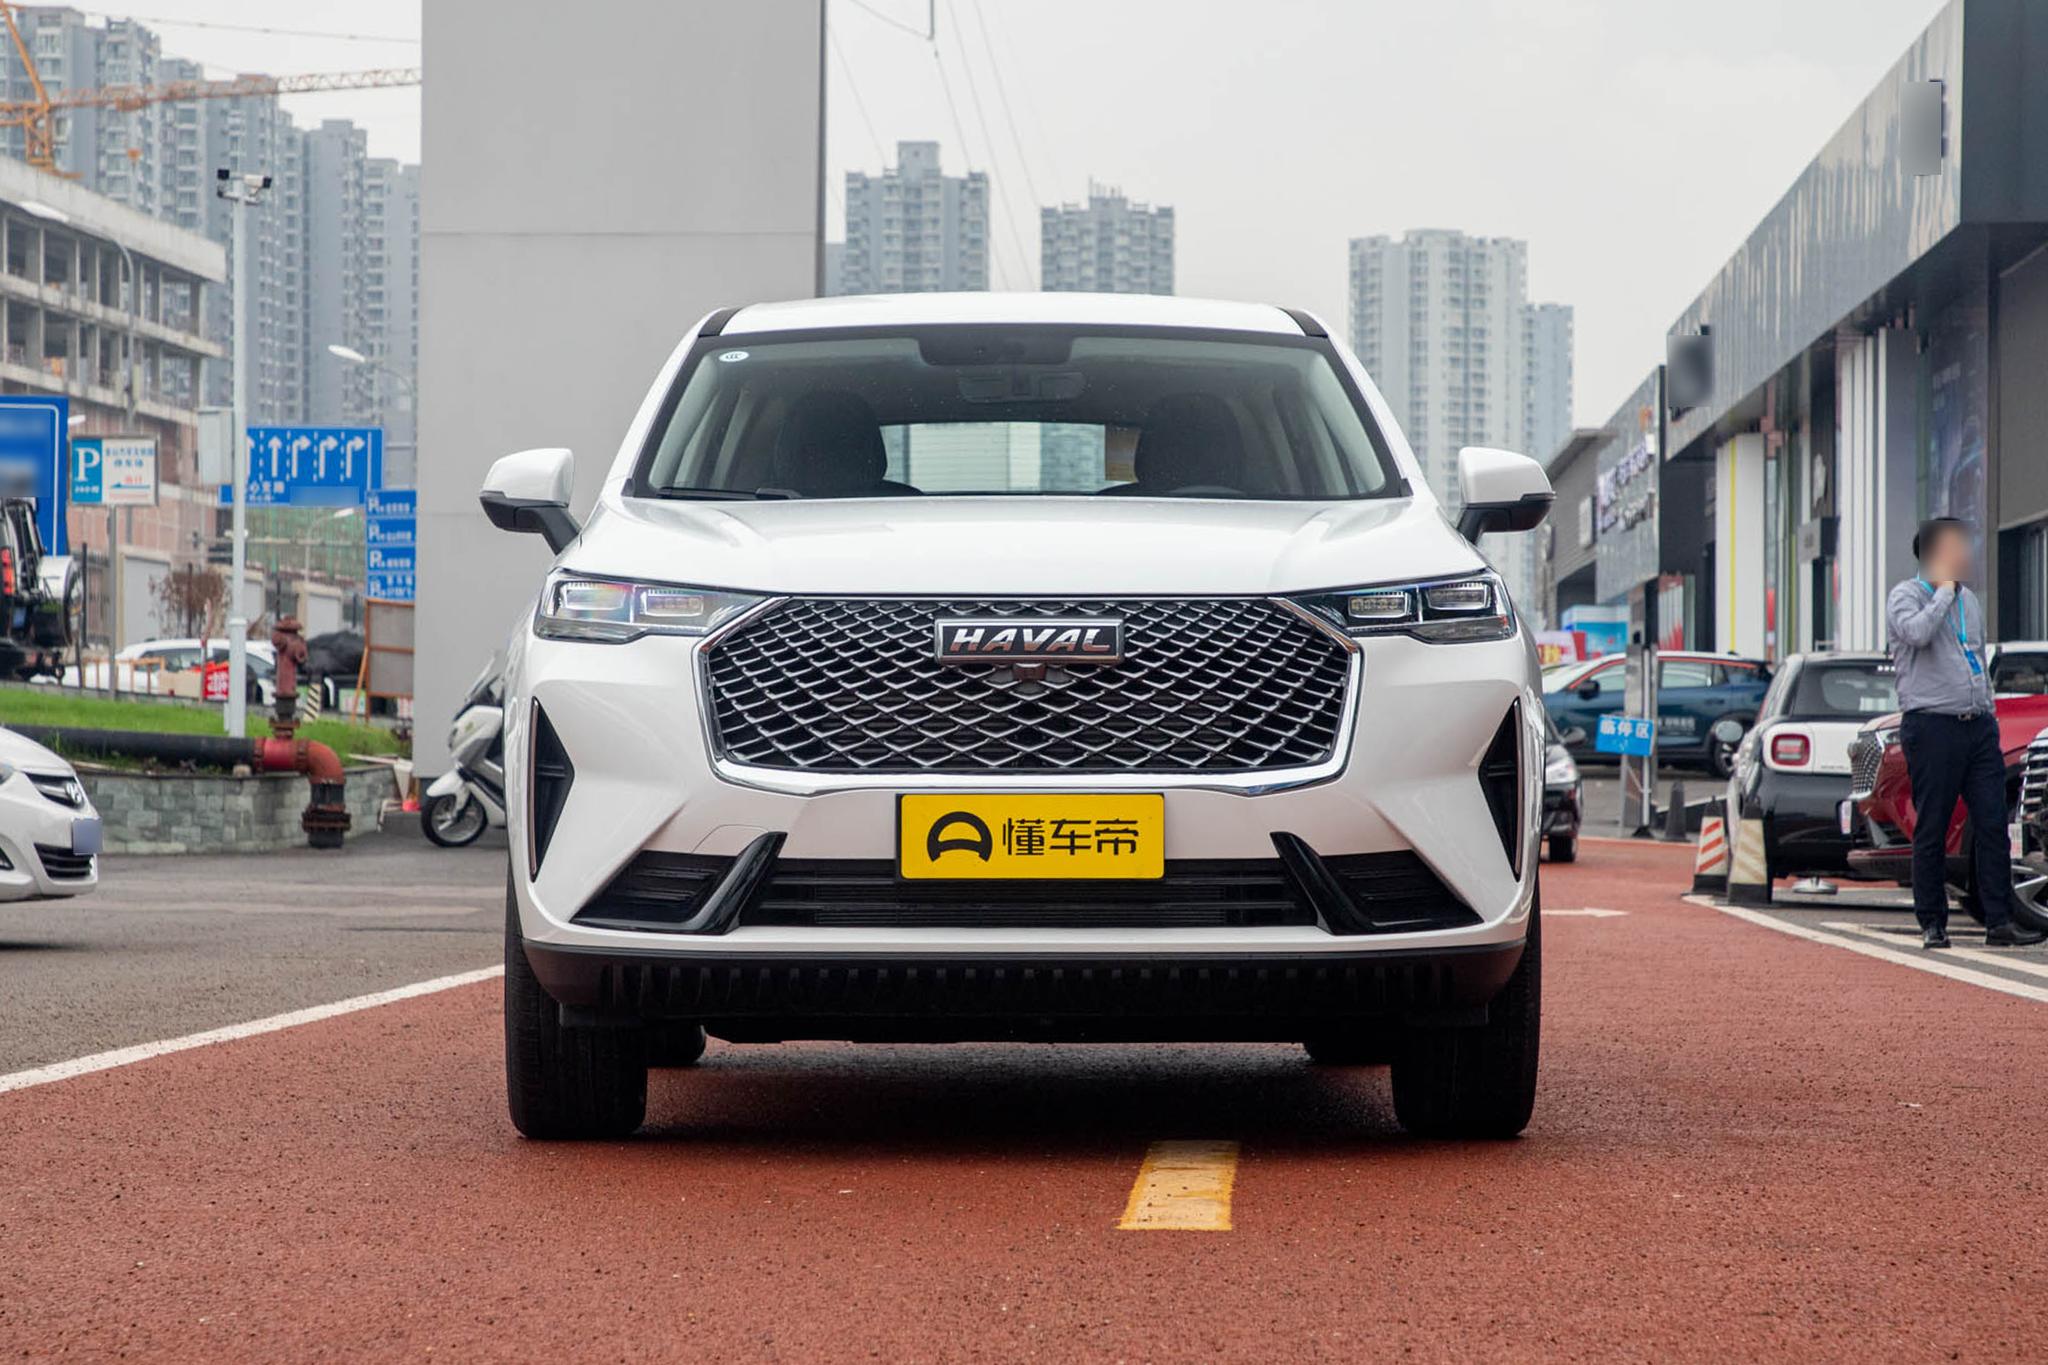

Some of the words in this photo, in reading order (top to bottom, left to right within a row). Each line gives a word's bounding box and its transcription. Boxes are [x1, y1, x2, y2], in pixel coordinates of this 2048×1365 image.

[75, 447, 100, 482] P
[950, 628, 1111, 652] HAVAL
[1002, 818, 1139, 856] 懂车帝
